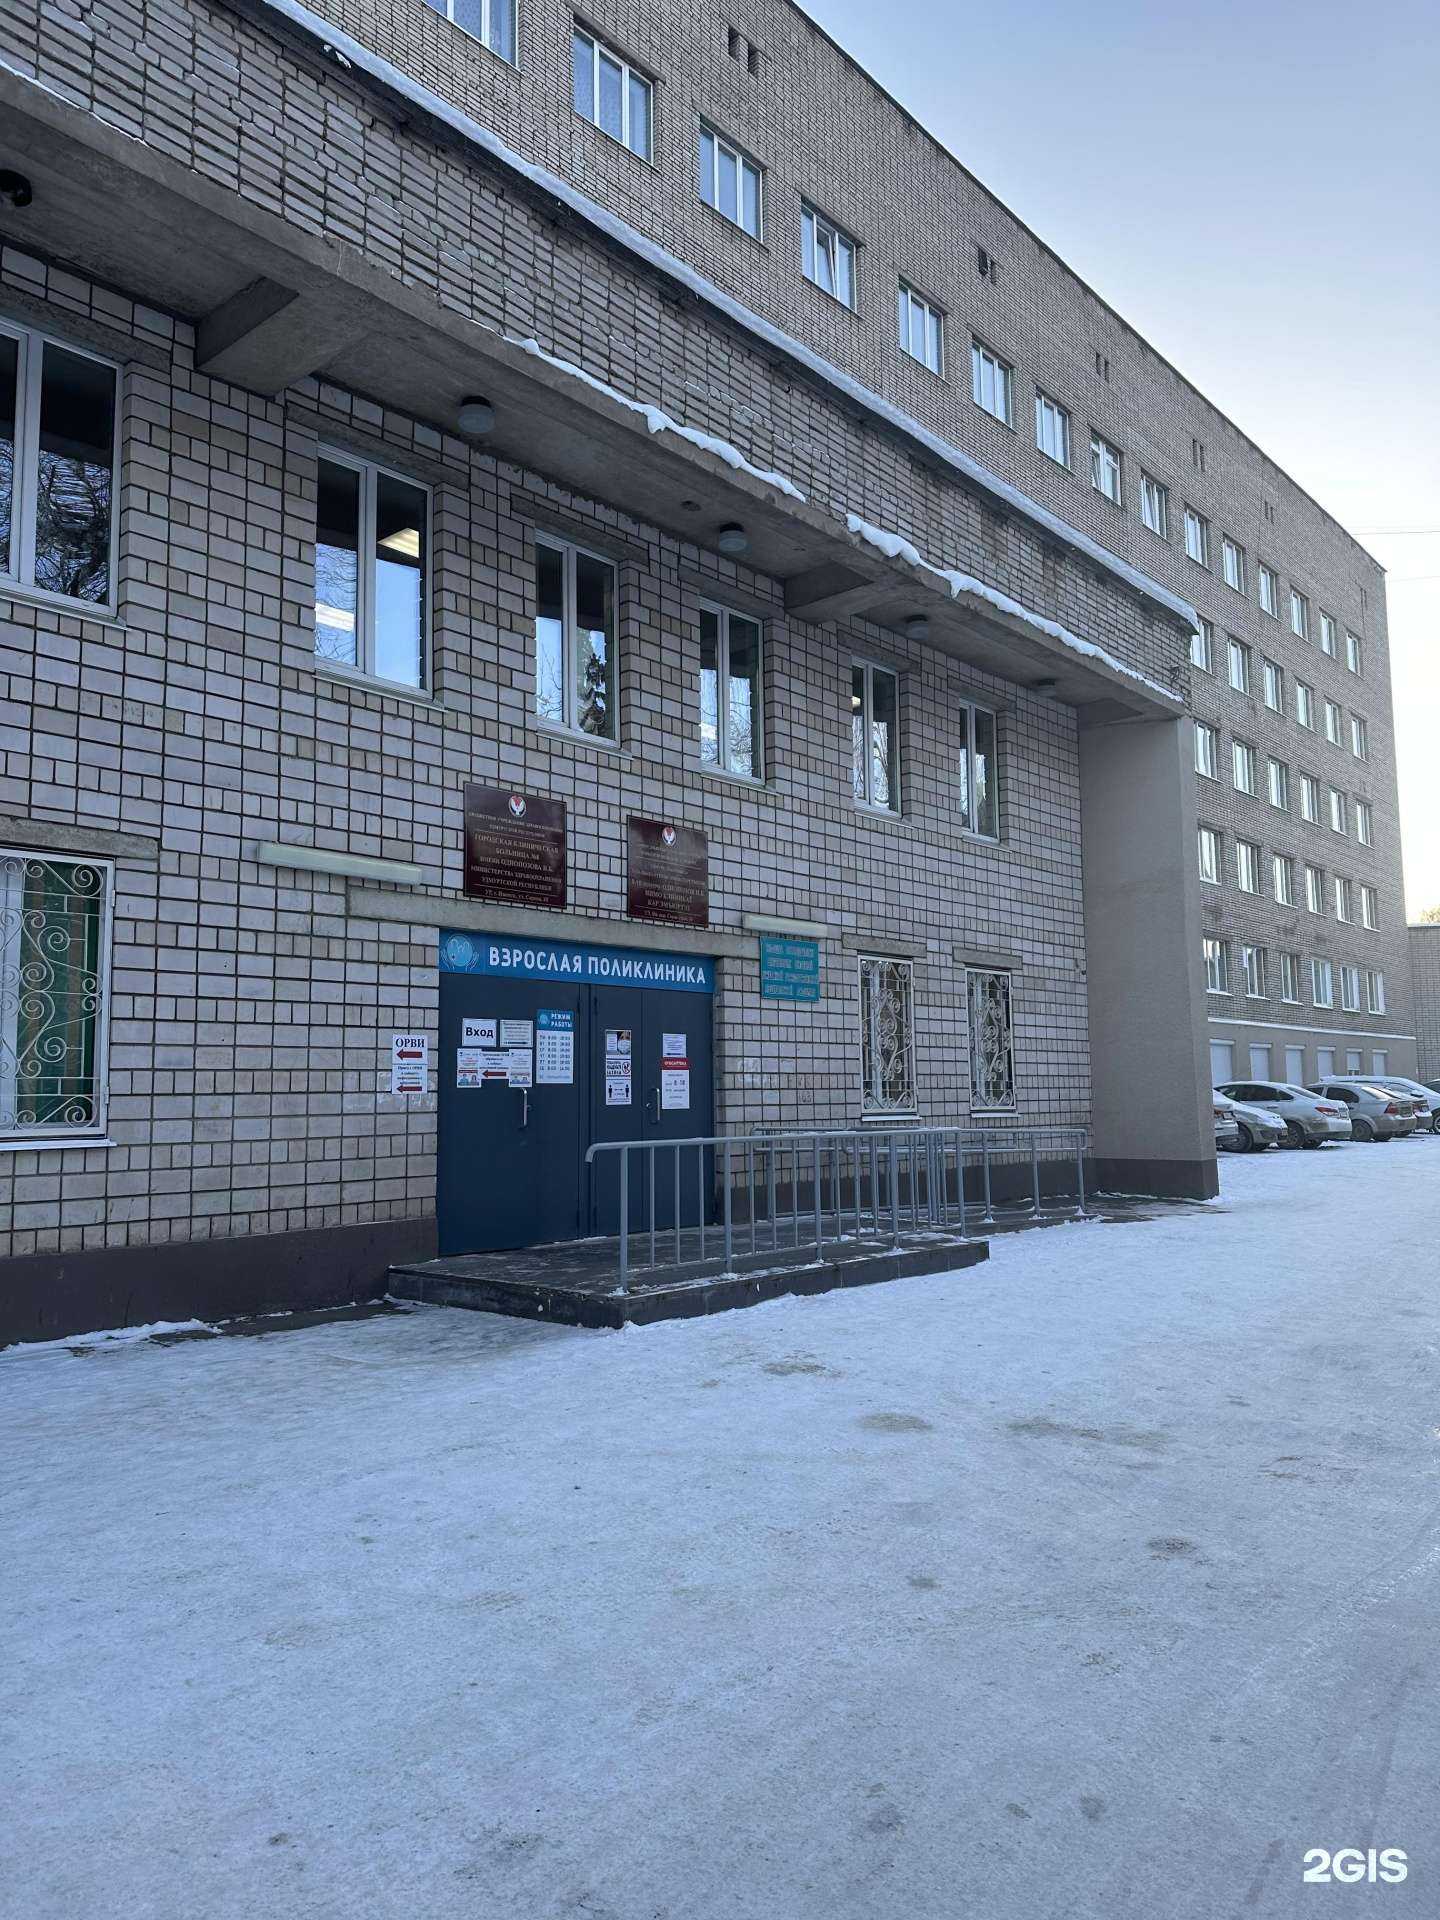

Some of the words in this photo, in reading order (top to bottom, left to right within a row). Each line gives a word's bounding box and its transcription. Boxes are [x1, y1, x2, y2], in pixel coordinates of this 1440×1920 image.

[474, 833, 512, 846] ГОРОДСКАЯ
[495, 847, 530, 859] БОЛЬНИЦА
[489, 946, 582, 974] ВЗРОСЛАЯ
[588, 956, 706, 985] ПОЛИКЛИНИКА
[466, 1027, 494, 1039] Вход
[395, 1038, 425, 1048] ОРВИ
